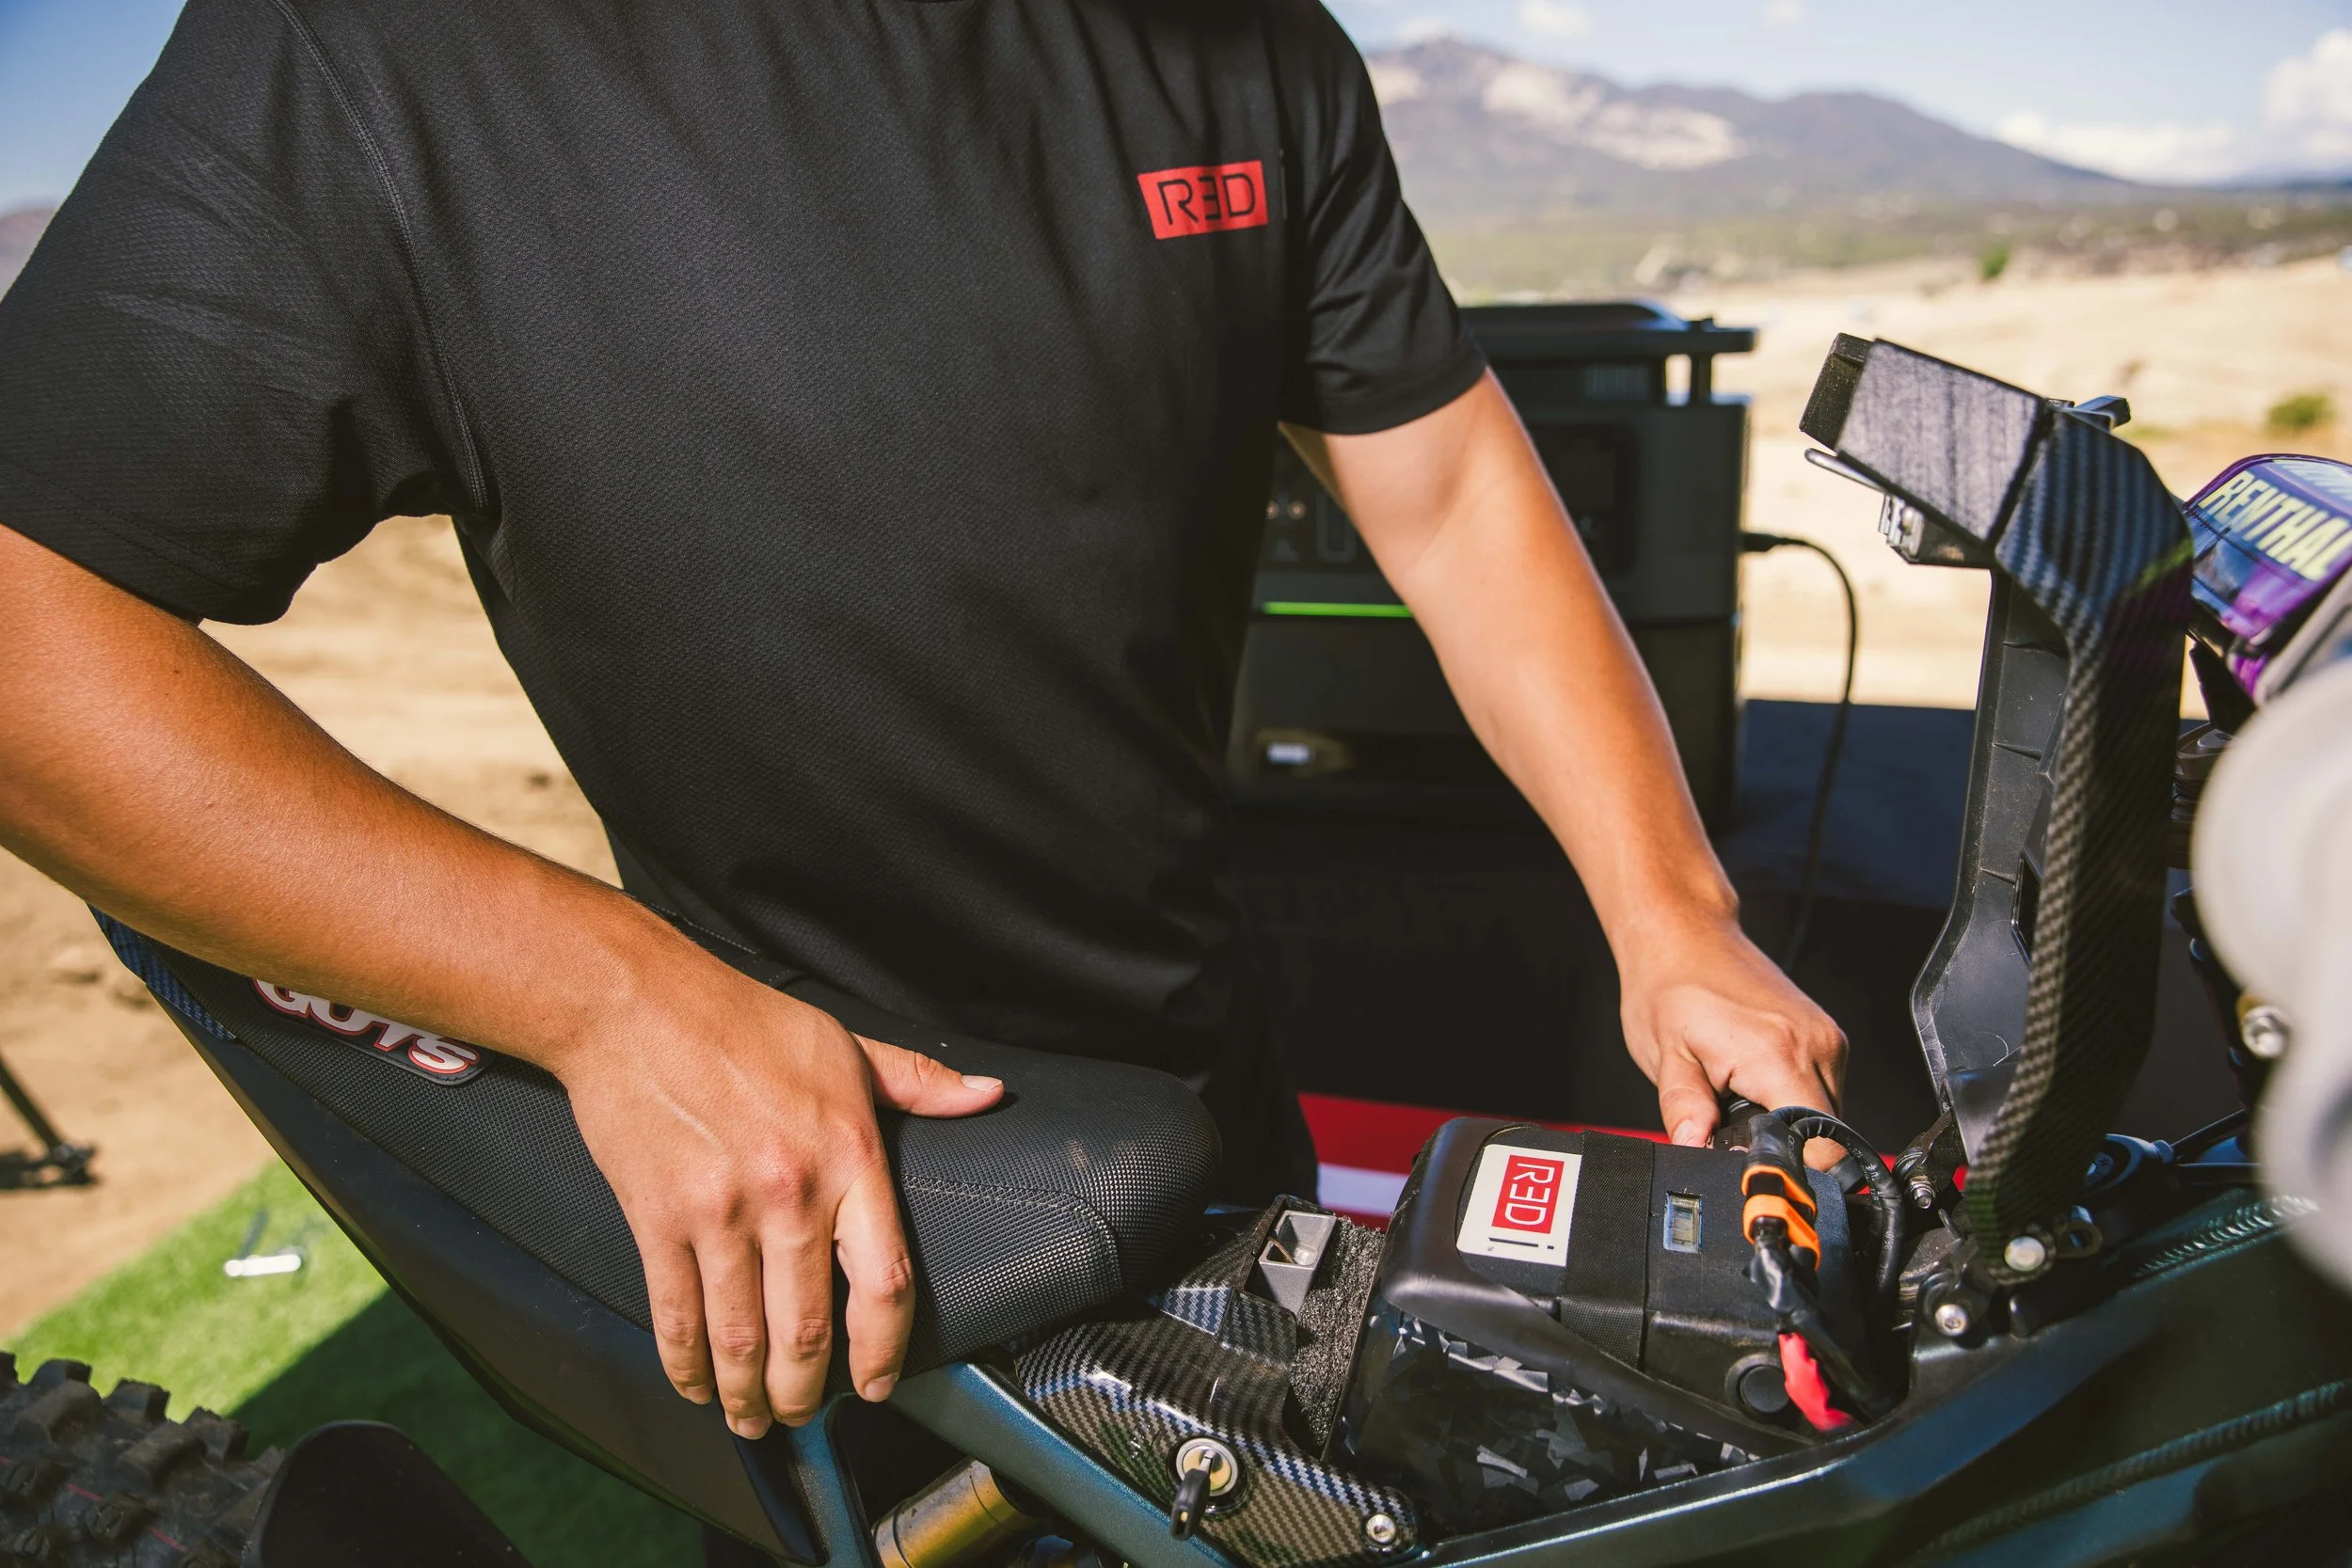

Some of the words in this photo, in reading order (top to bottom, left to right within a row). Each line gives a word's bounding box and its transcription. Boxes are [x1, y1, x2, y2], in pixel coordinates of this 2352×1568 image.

[1156, 173, 1256, 226] RED
[2198, 469, 2352, 581] RENTHAL
[1504, 1163, 1555, 1226] RED
